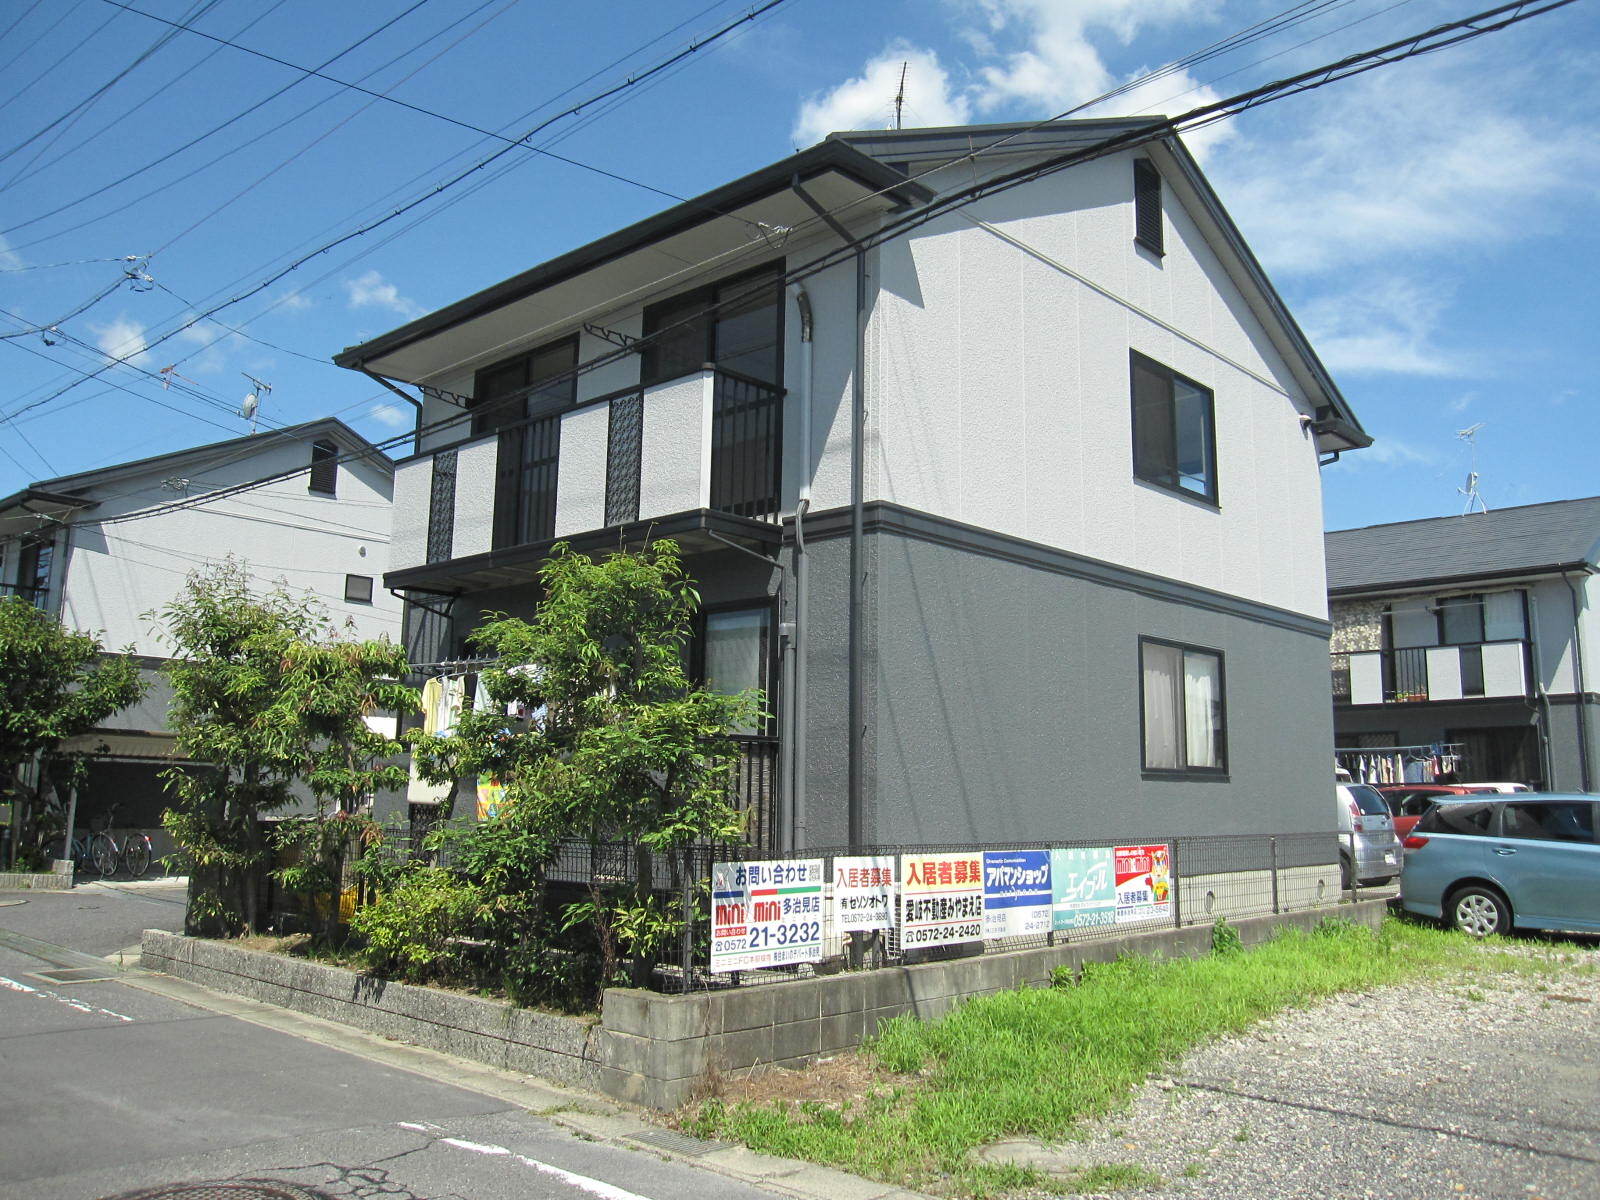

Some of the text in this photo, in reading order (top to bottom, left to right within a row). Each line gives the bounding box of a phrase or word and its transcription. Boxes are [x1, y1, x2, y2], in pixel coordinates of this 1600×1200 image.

[736, 864, 807, 886] お問い合わせ
[836, 868, 892, 888] 入居者募集
[907, 860, 981, 886] 入居者募集
[986, 863, 1049, 887] アパマンショップ
[1060, 861, 1108, 903] エイブル
[906, 895, 982, 922] 愛岐不動産みやまえ店
[1117, 890, 1149, 905] 入居者募集
[716, 896, 820, 926] mini mini 多治見店
[724, 921, 820, 951] 0572 21-3232
[916, 924, 981, 942] 0572-24-2420
